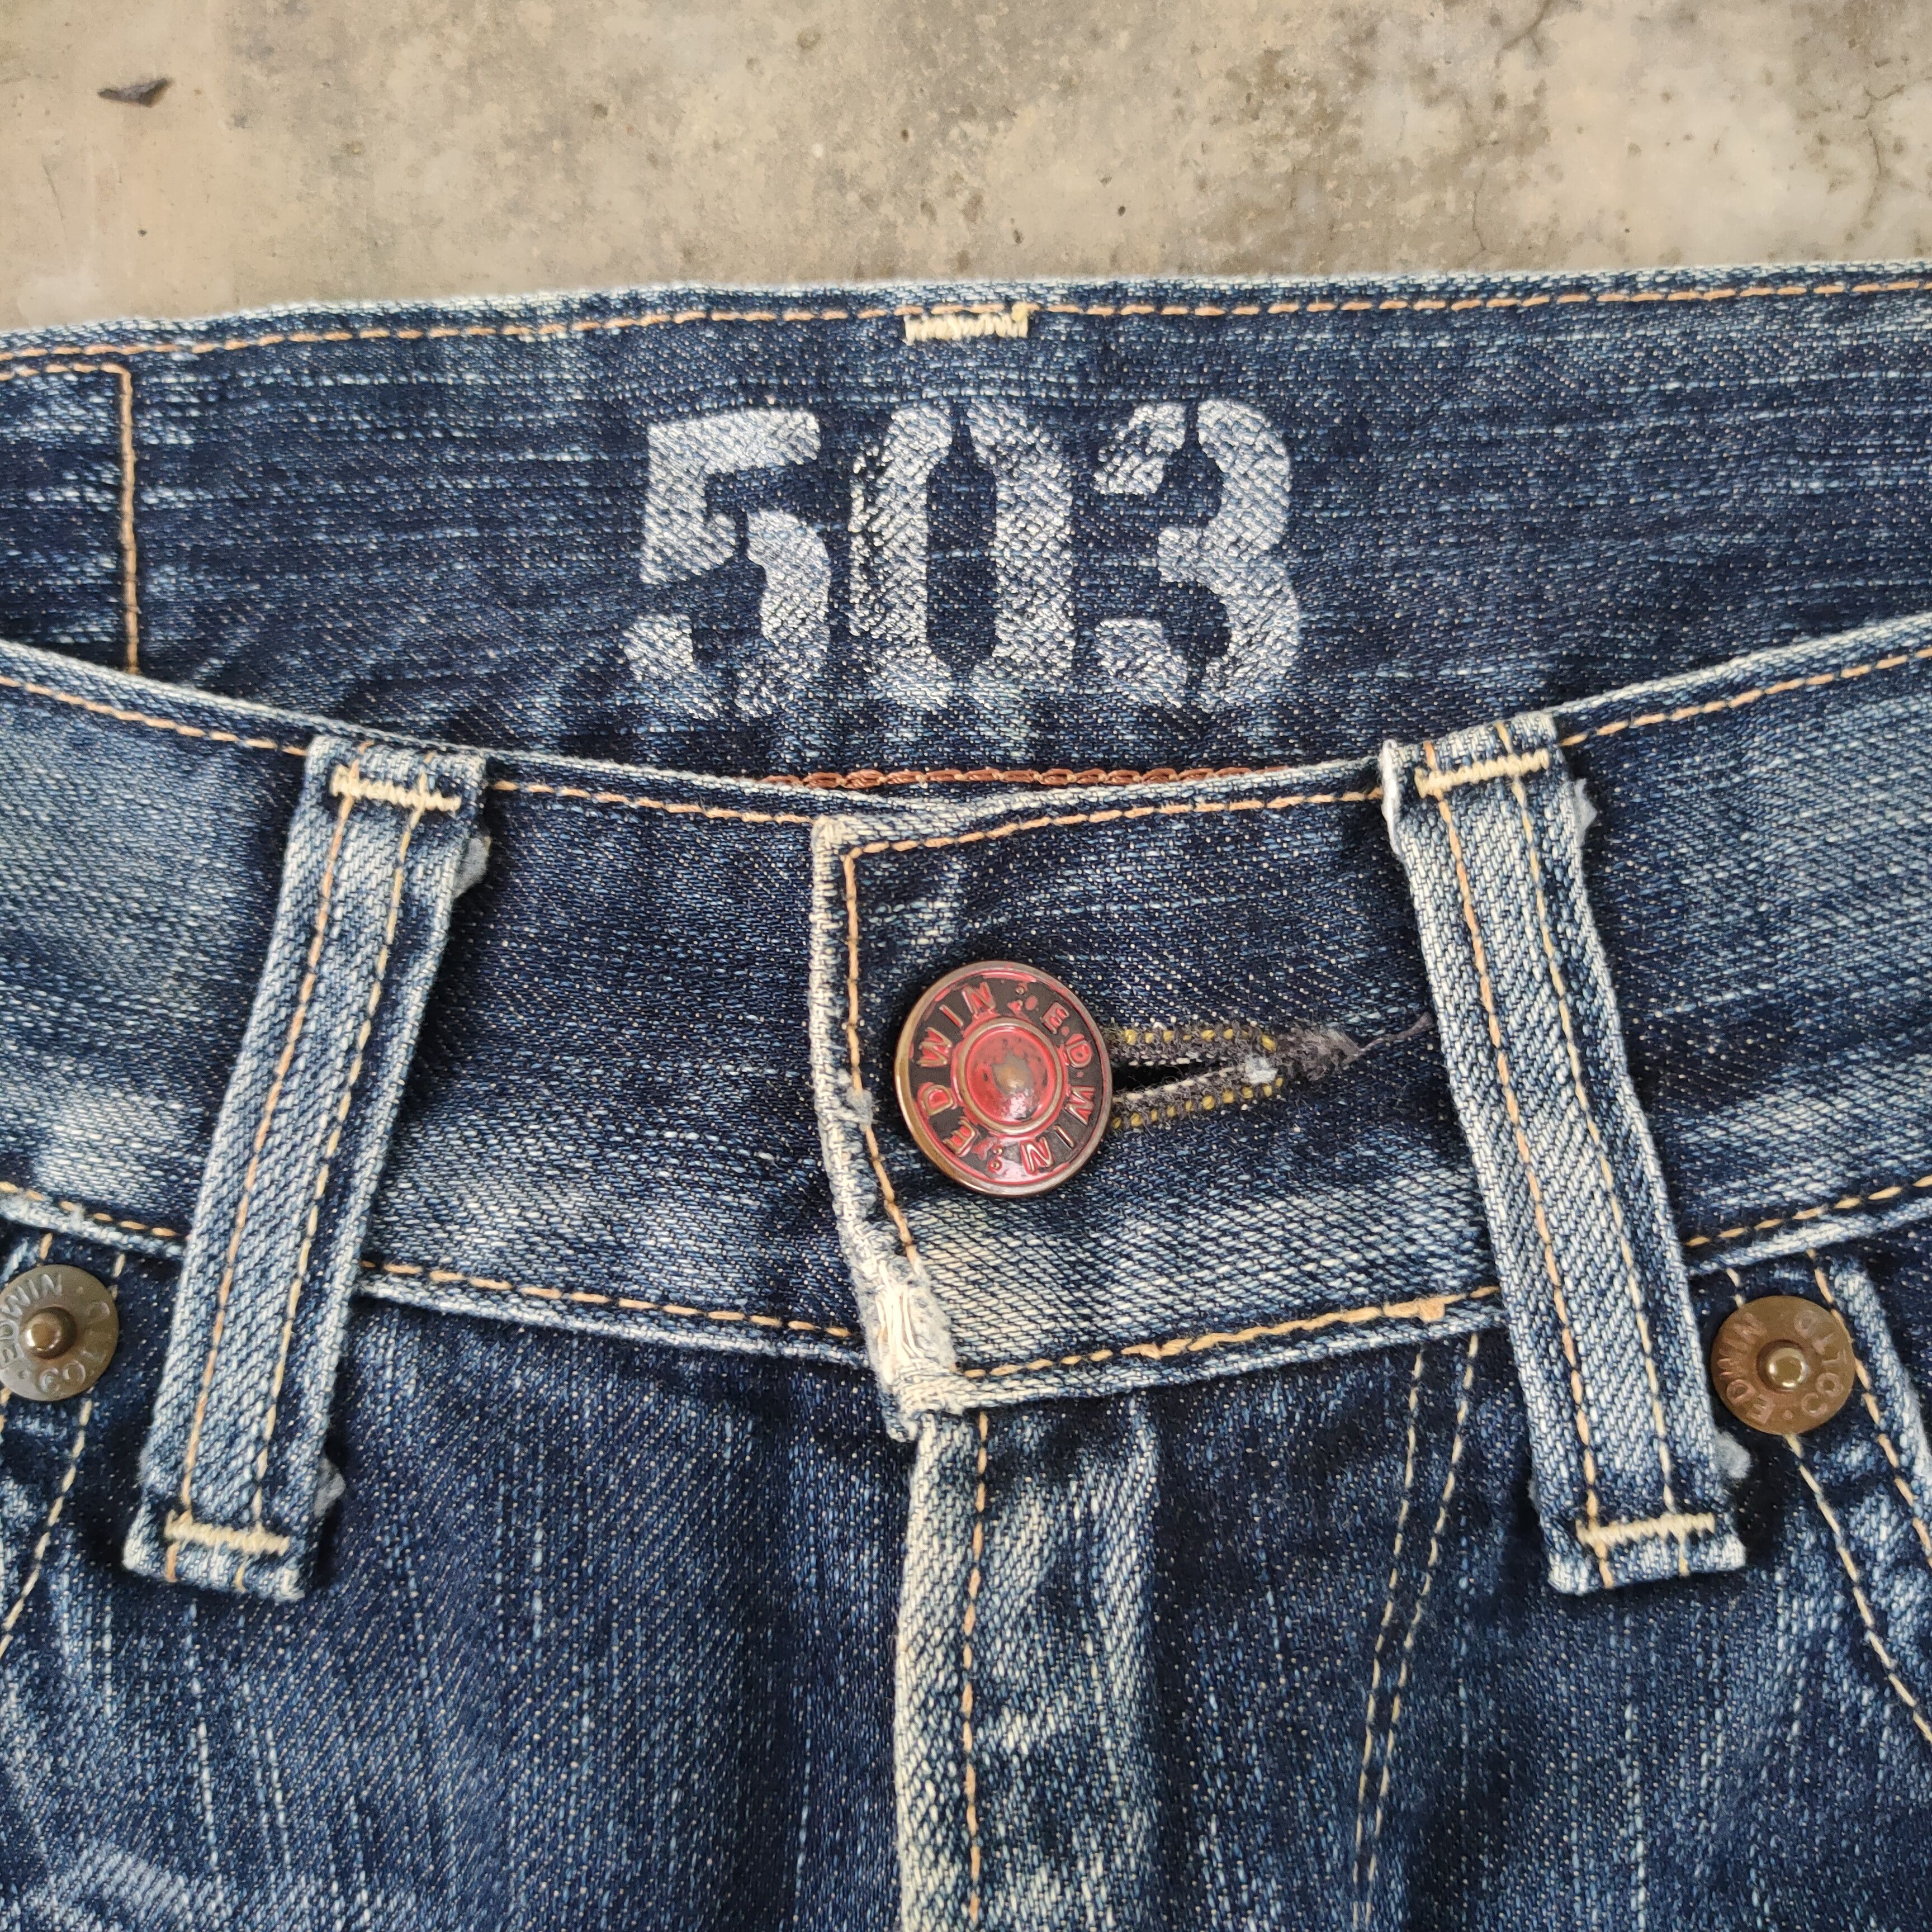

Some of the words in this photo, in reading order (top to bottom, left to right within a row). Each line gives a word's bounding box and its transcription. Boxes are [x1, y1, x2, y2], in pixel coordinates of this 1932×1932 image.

[622, 398, 1303, 719] 503
[915, 982, 996, 1157] EDWIN
[1020, 1001, 1096, 1173] EDWIN
[1717, 1312, 1774, 1424] EDWIN
